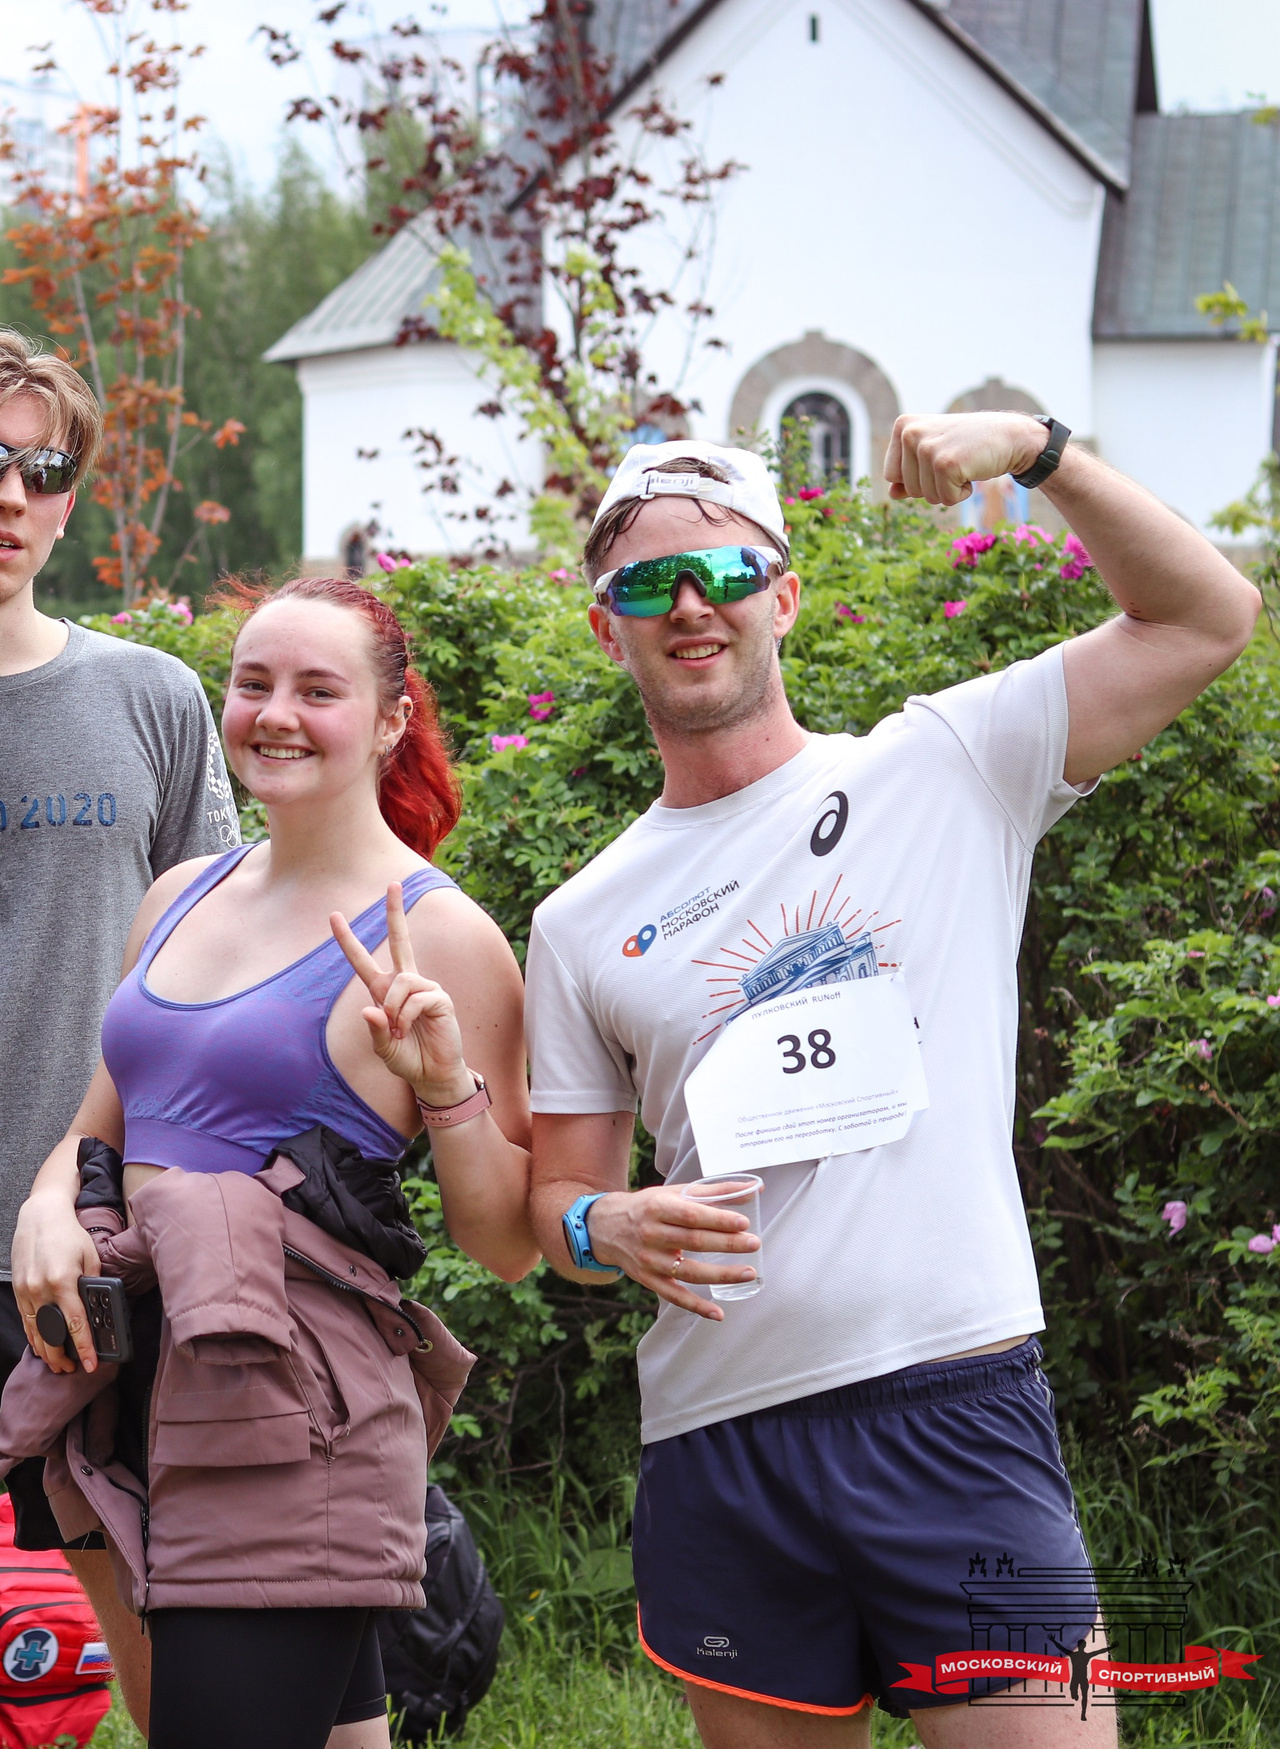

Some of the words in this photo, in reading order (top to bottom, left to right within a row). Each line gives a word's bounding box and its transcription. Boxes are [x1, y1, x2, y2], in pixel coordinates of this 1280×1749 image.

[19, 792, 118, 829] 2020
[659, 886, 711, 923] АБСОЛЮТ
[661, 880, 740, 932] МОСКОВСКИЙ
[663, 903, 720, 940] МАРАФОН
[777, 1029, 836, 1074] 38
[696, 1646, 738, 1659] Kalenji
